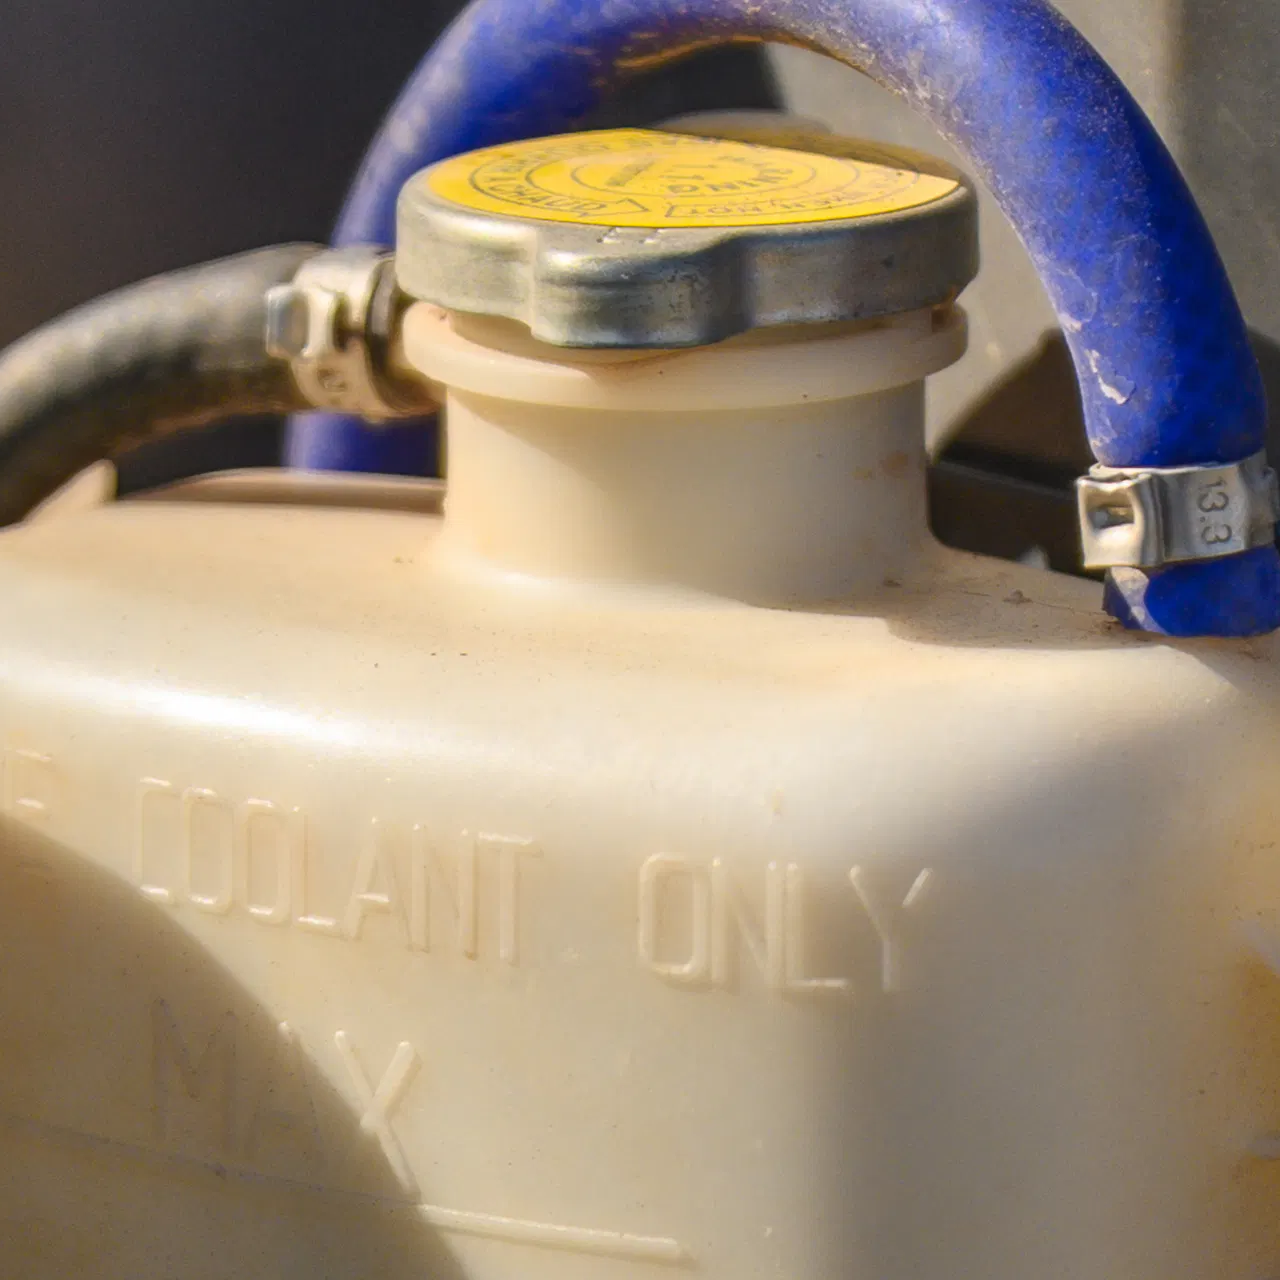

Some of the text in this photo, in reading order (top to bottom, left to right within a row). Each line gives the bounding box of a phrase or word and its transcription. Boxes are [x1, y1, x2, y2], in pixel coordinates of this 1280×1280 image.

[1196, 475, 1233, 545] 13.3
[135, 775, 544, 967] COOLANT
[638, 850, 934, 997] ONLY
